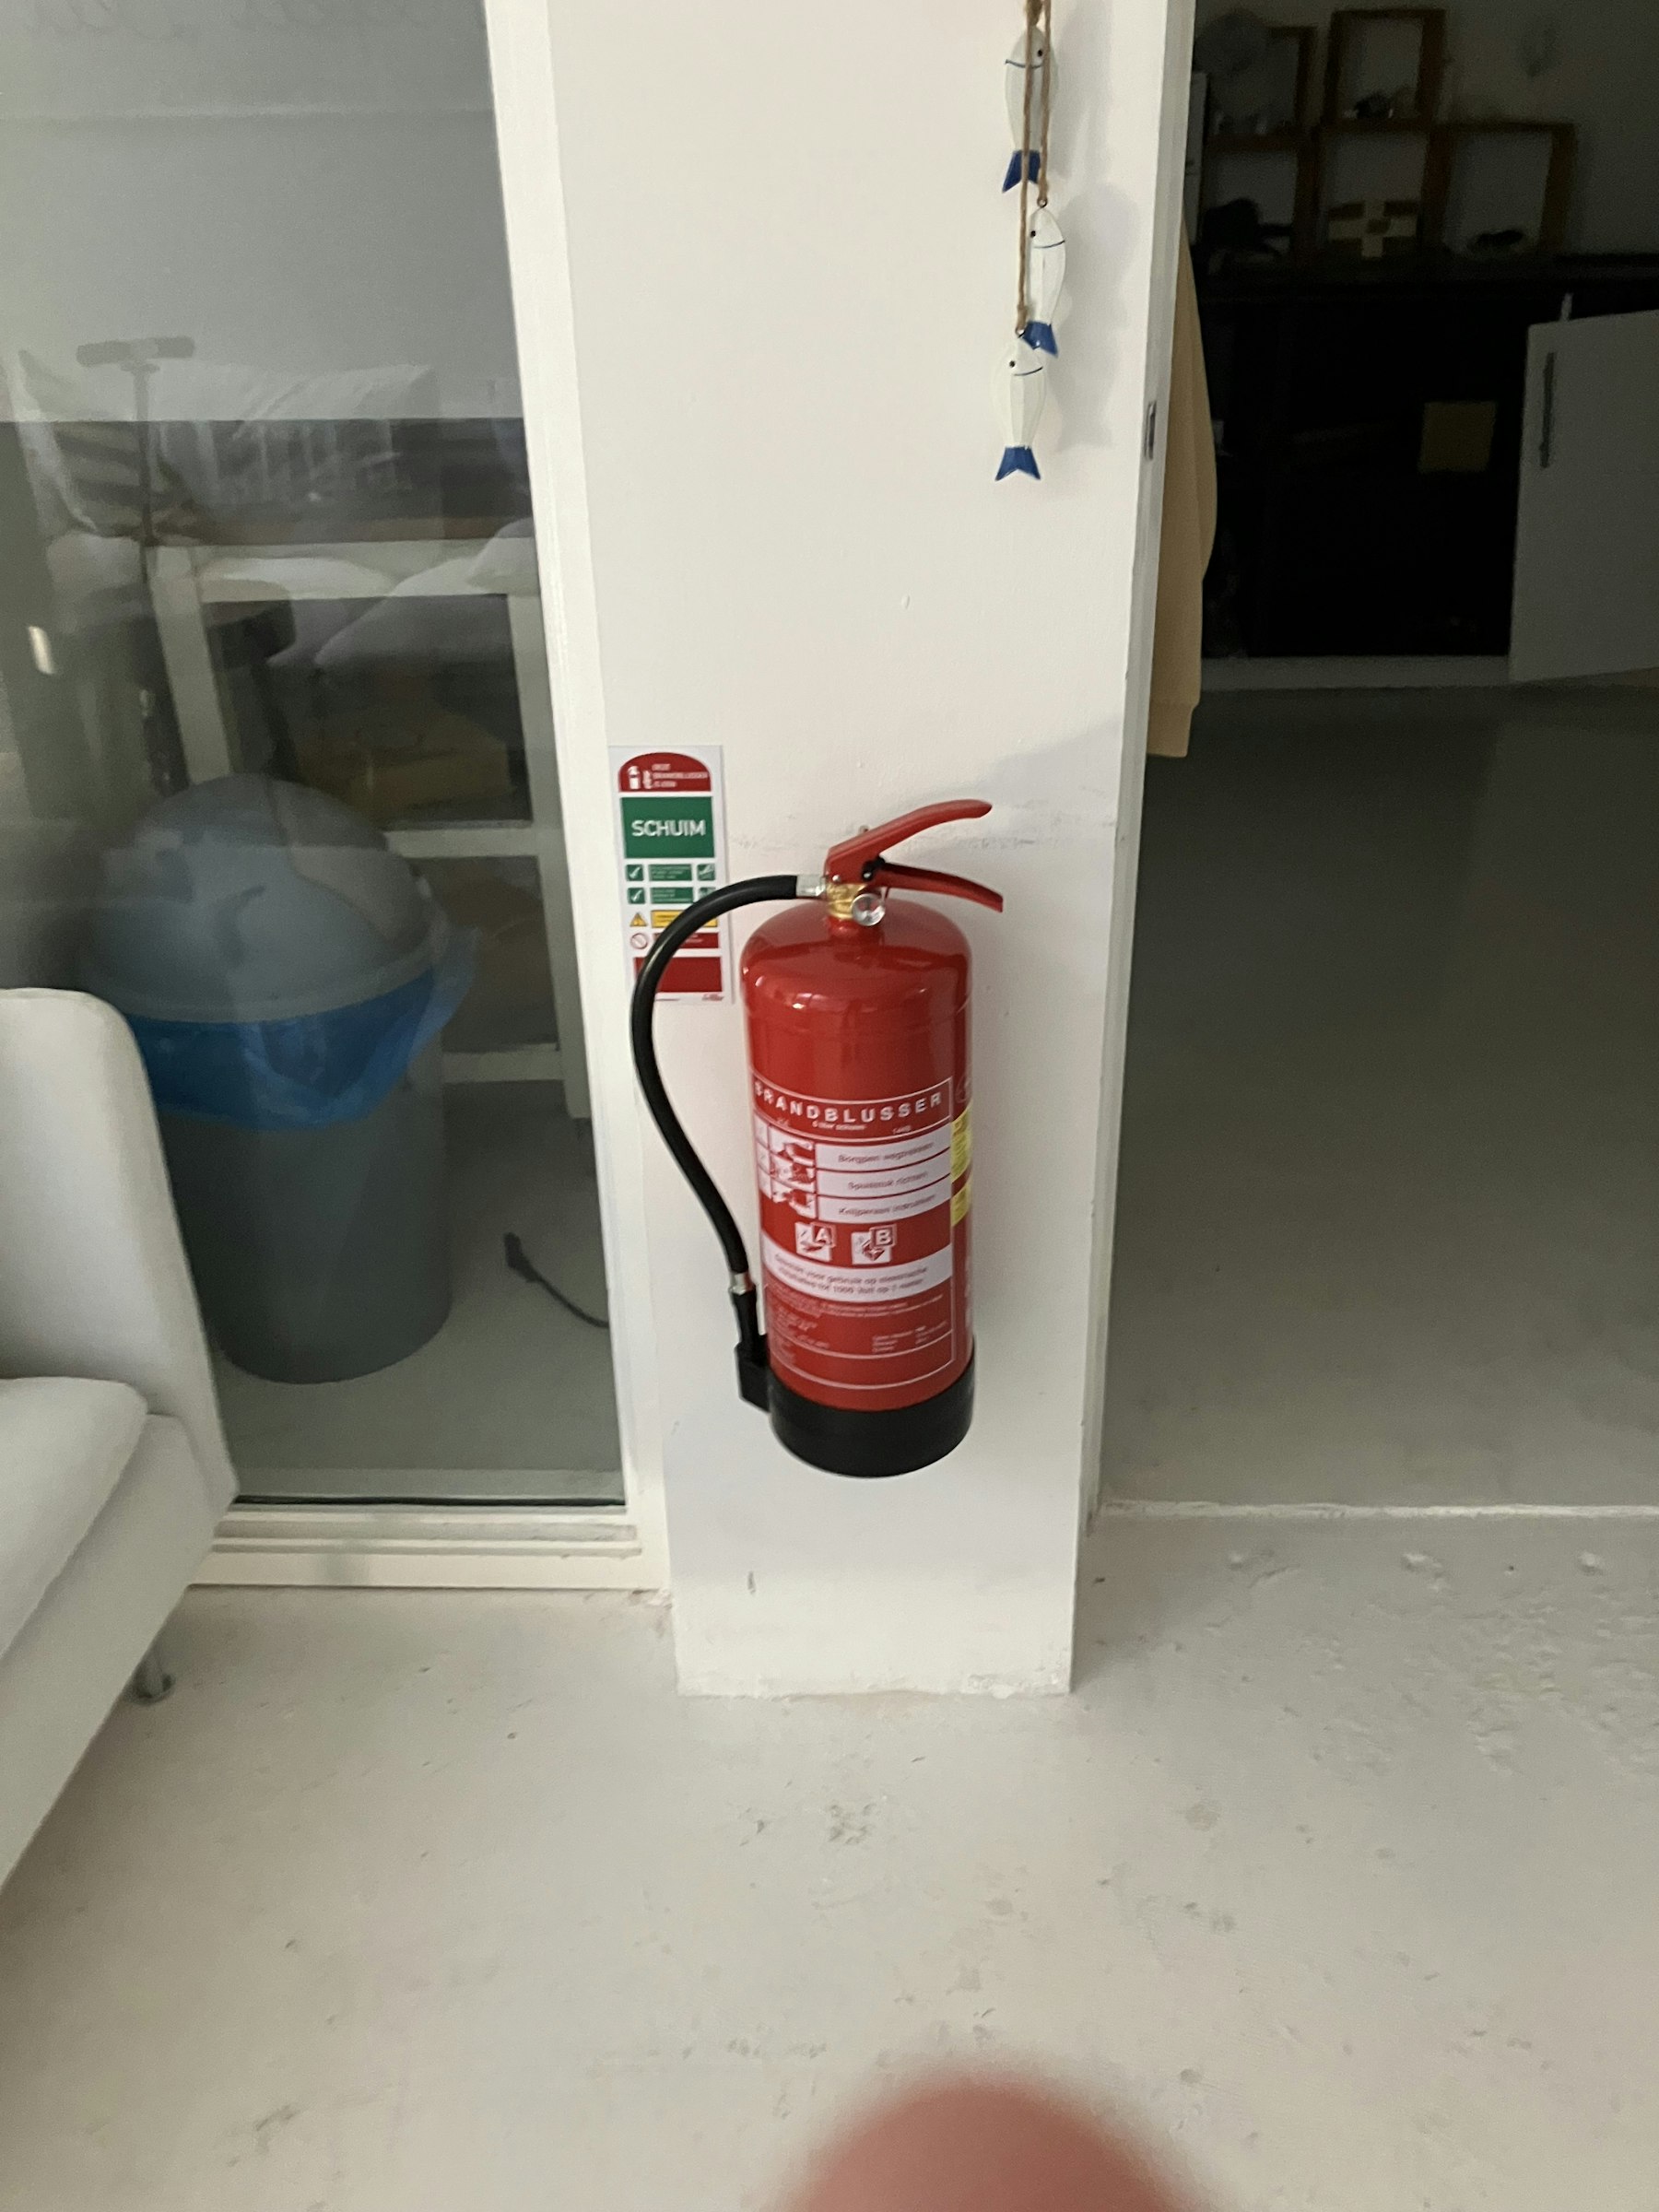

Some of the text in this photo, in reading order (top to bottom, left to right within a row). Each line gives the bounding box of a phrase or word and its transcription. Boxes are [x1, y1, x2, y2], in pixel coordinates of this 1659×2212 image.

[631, 818, 707, 837] SCHUIM
[755, 1081, 942, 1124] BRANDBLUSSER
[815, 1227, 891, 1245] A B
